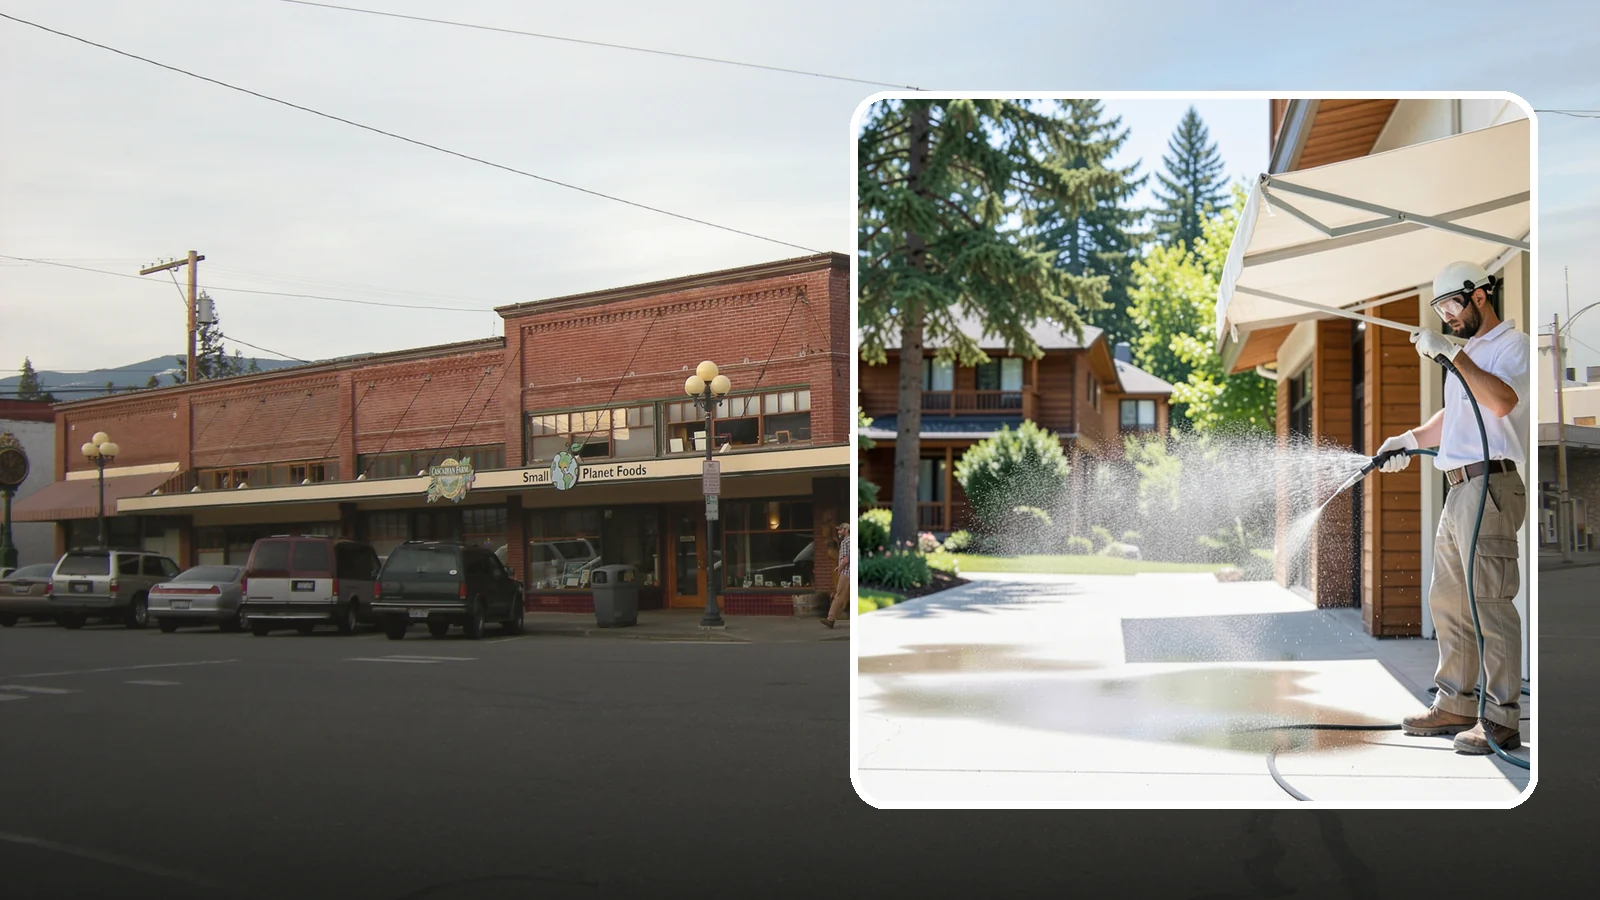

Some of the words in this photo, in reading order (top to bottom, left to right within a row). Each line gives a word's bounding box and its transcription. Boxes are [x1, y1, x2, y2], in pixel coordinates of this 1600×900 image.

[523, 471, 549, 483] Small
[582, 467, 614, 479] Planet
[617, 464, 647, 477] Foods
